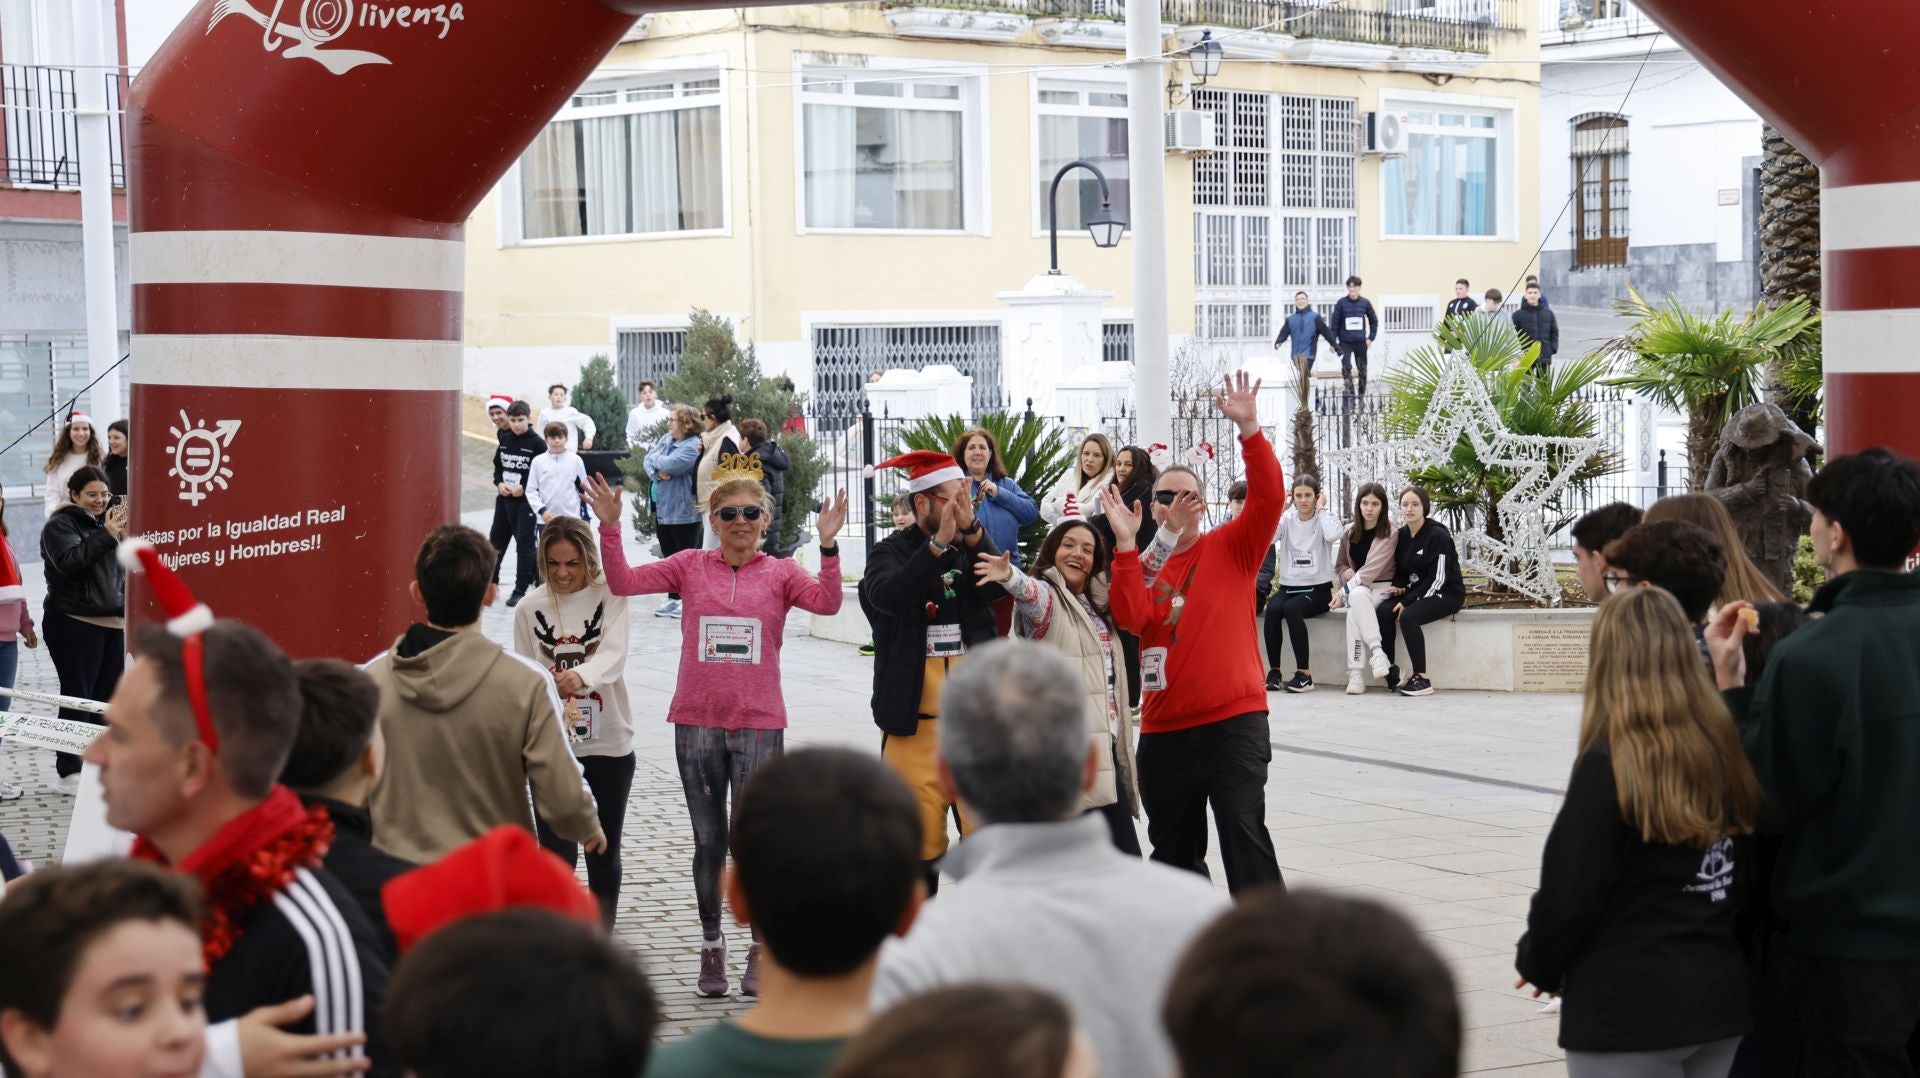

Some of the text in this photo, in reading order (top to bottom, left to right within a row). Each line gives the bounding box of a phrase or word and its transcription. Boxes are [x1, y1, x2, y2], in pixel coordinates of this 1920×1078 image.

[717, 451, 763, 471] 2026
[178, 526, 203, 546] por
[208, 522, 221, 538] la
[226, 511, 301, 540] Igualdad
[307, 505, 346, 526] Real
[158, 533, 322, 572] Mujeres y Hombres!!
